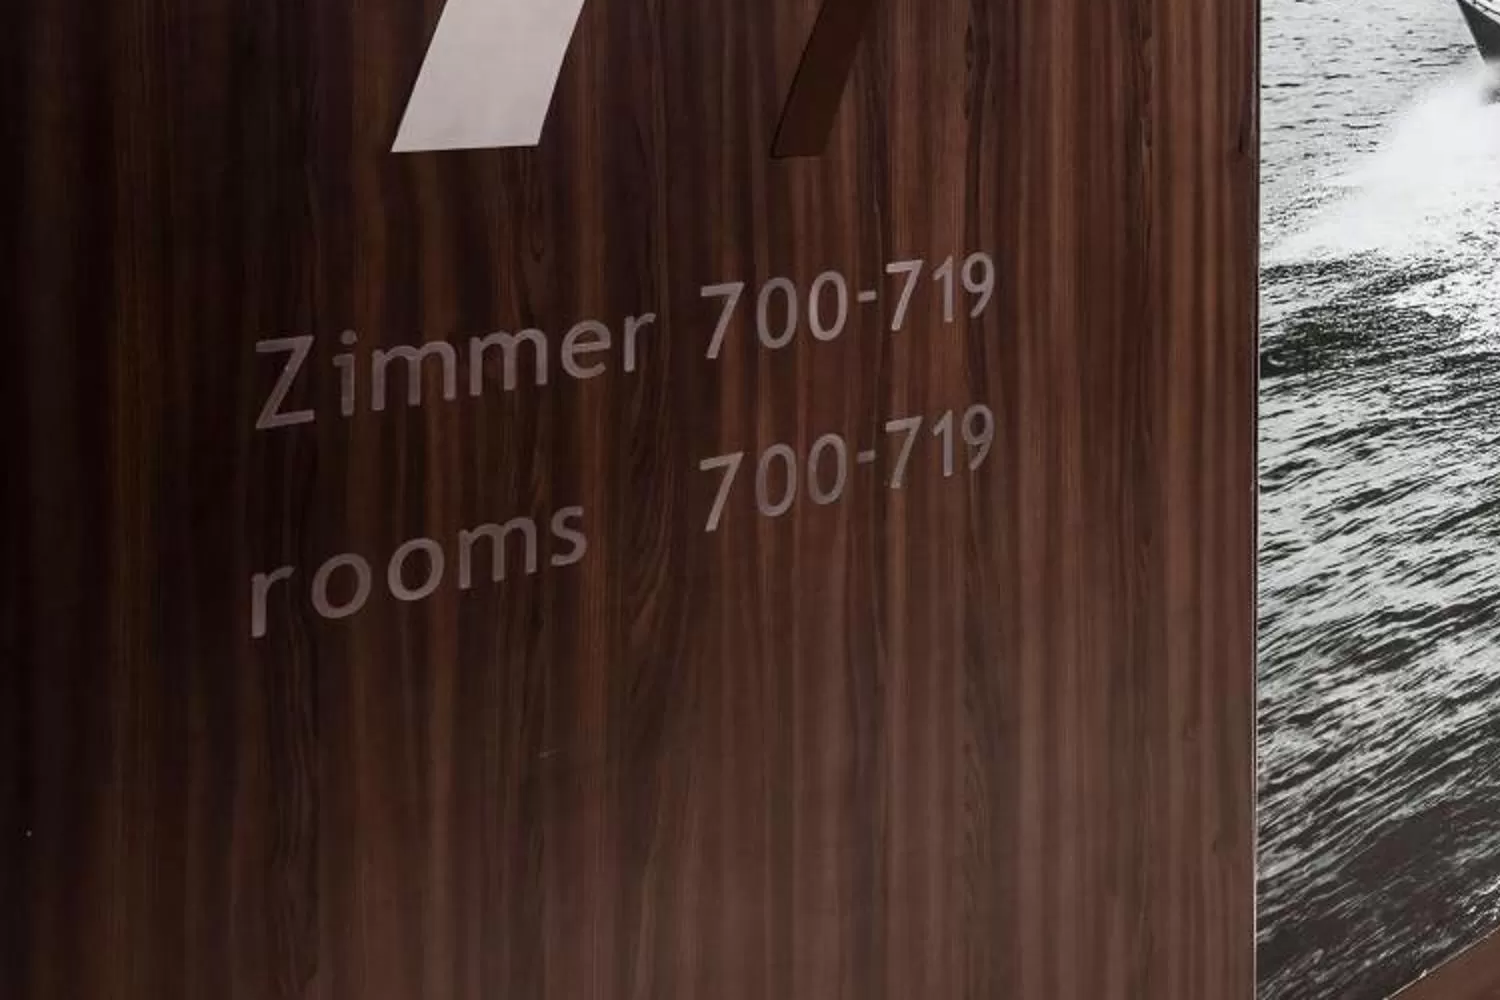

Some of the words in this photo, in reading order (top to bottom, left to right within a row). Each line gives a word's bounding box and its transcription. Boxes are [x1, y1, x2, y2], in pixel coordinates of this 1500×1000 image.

[254, 311, 656, 429] Zimmer
[699, 251, 995, 360] 700-719
[251, 505, 588, 639] rooms
[698, 404, 994, 532] 700-719
